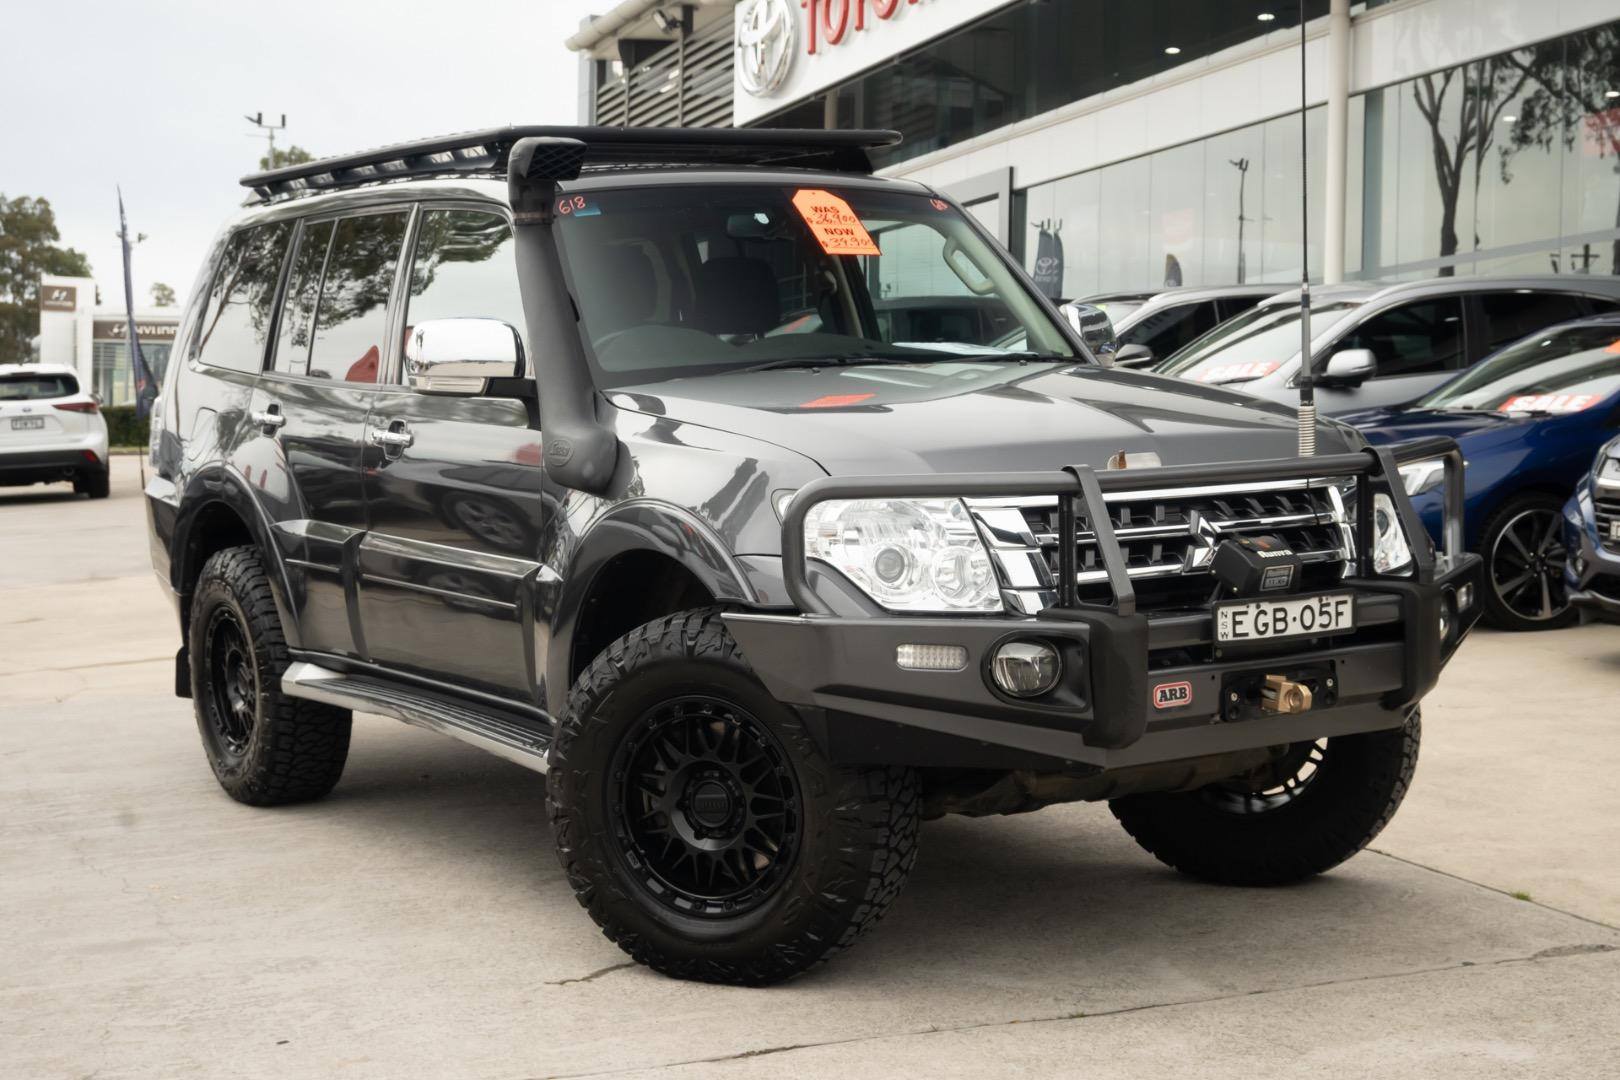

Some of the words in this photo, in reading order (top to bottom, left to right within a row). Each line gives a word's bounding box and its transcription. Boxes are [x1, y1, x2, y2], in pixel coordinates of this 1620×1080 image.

[559, 196, 586, 214] 618
[811, 206, 840, 214] WAS
[824, 227, 854, 236] NOW
[1507, 395, 1593, 414] SALE
[1220, 611, 1230, 639] NSW
[1159, 687, 1188, 702] ARB
